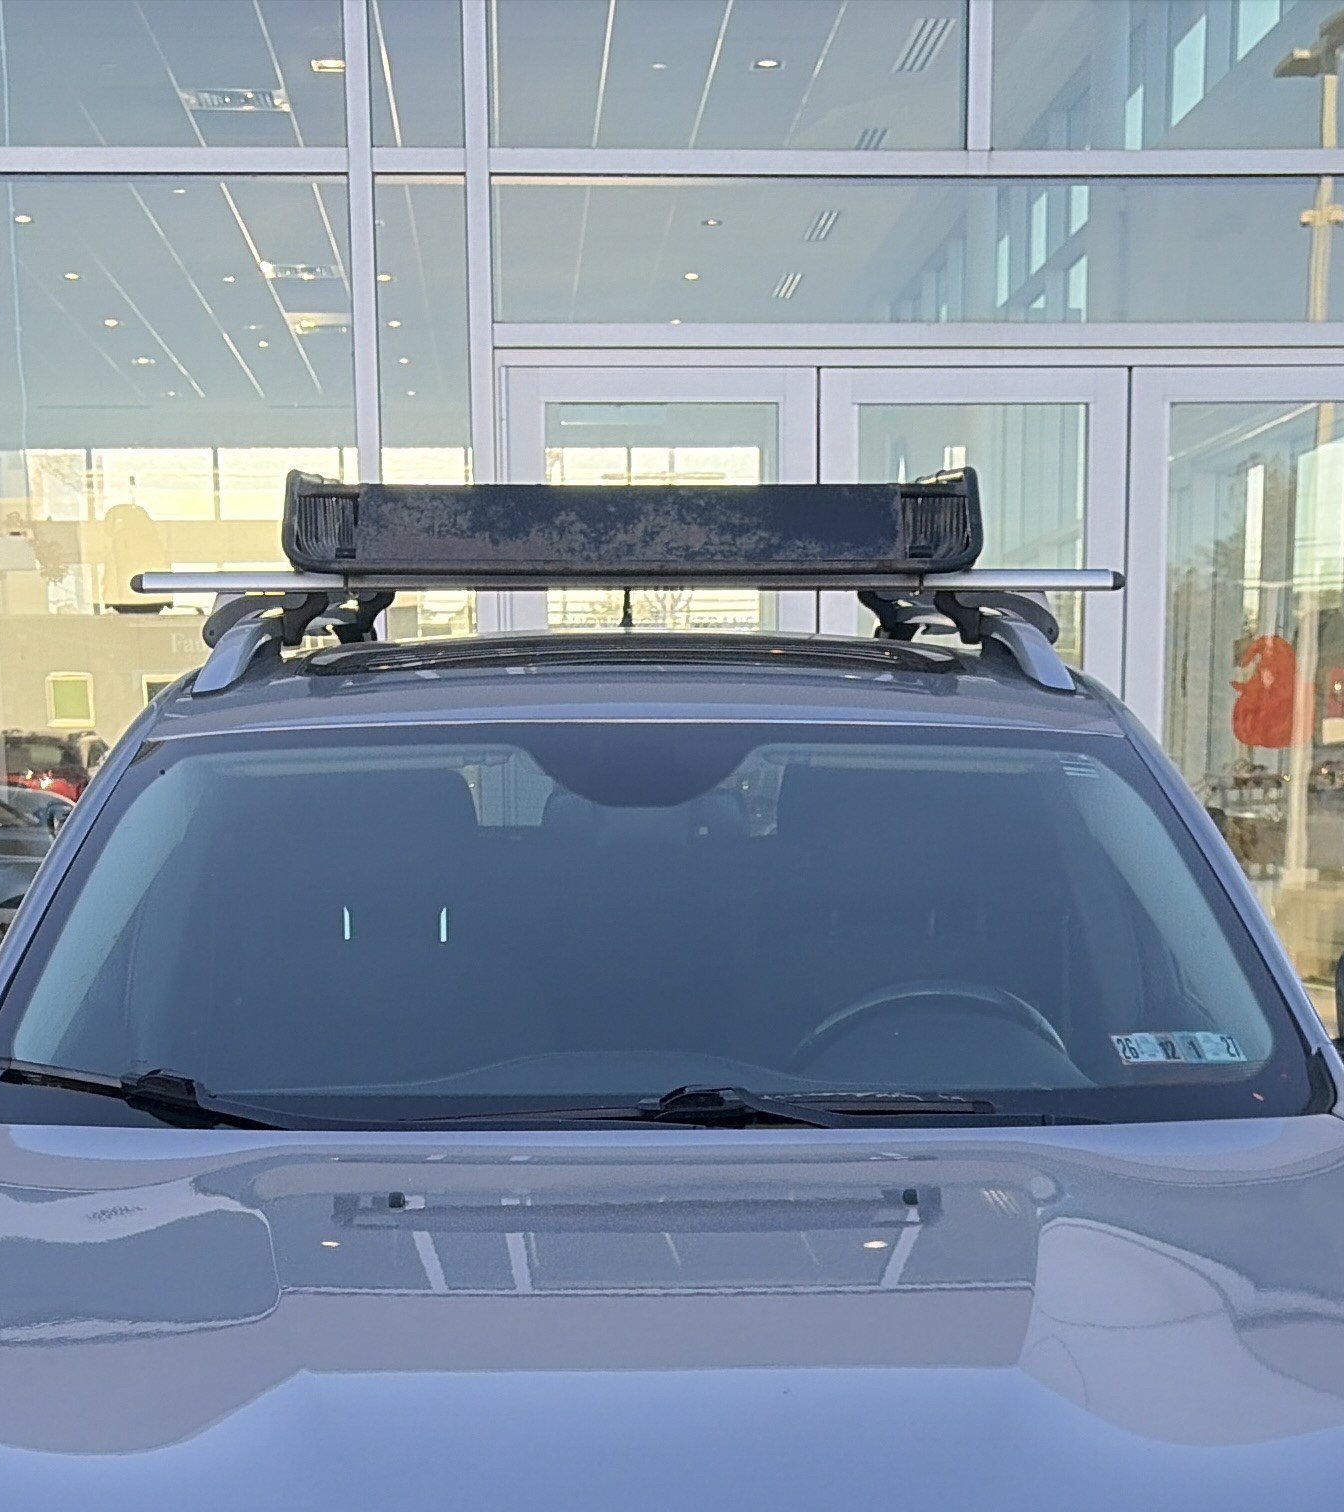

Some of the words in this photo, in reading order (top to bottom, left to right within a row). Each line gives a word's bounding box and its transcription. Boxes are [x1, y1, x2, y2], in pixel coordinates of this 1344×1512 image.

[1117, 1037, 1139, 1060] 26
[1158, 1040, 1181, 1060] 12
[1220, 1036, 1242, 1058] 27
